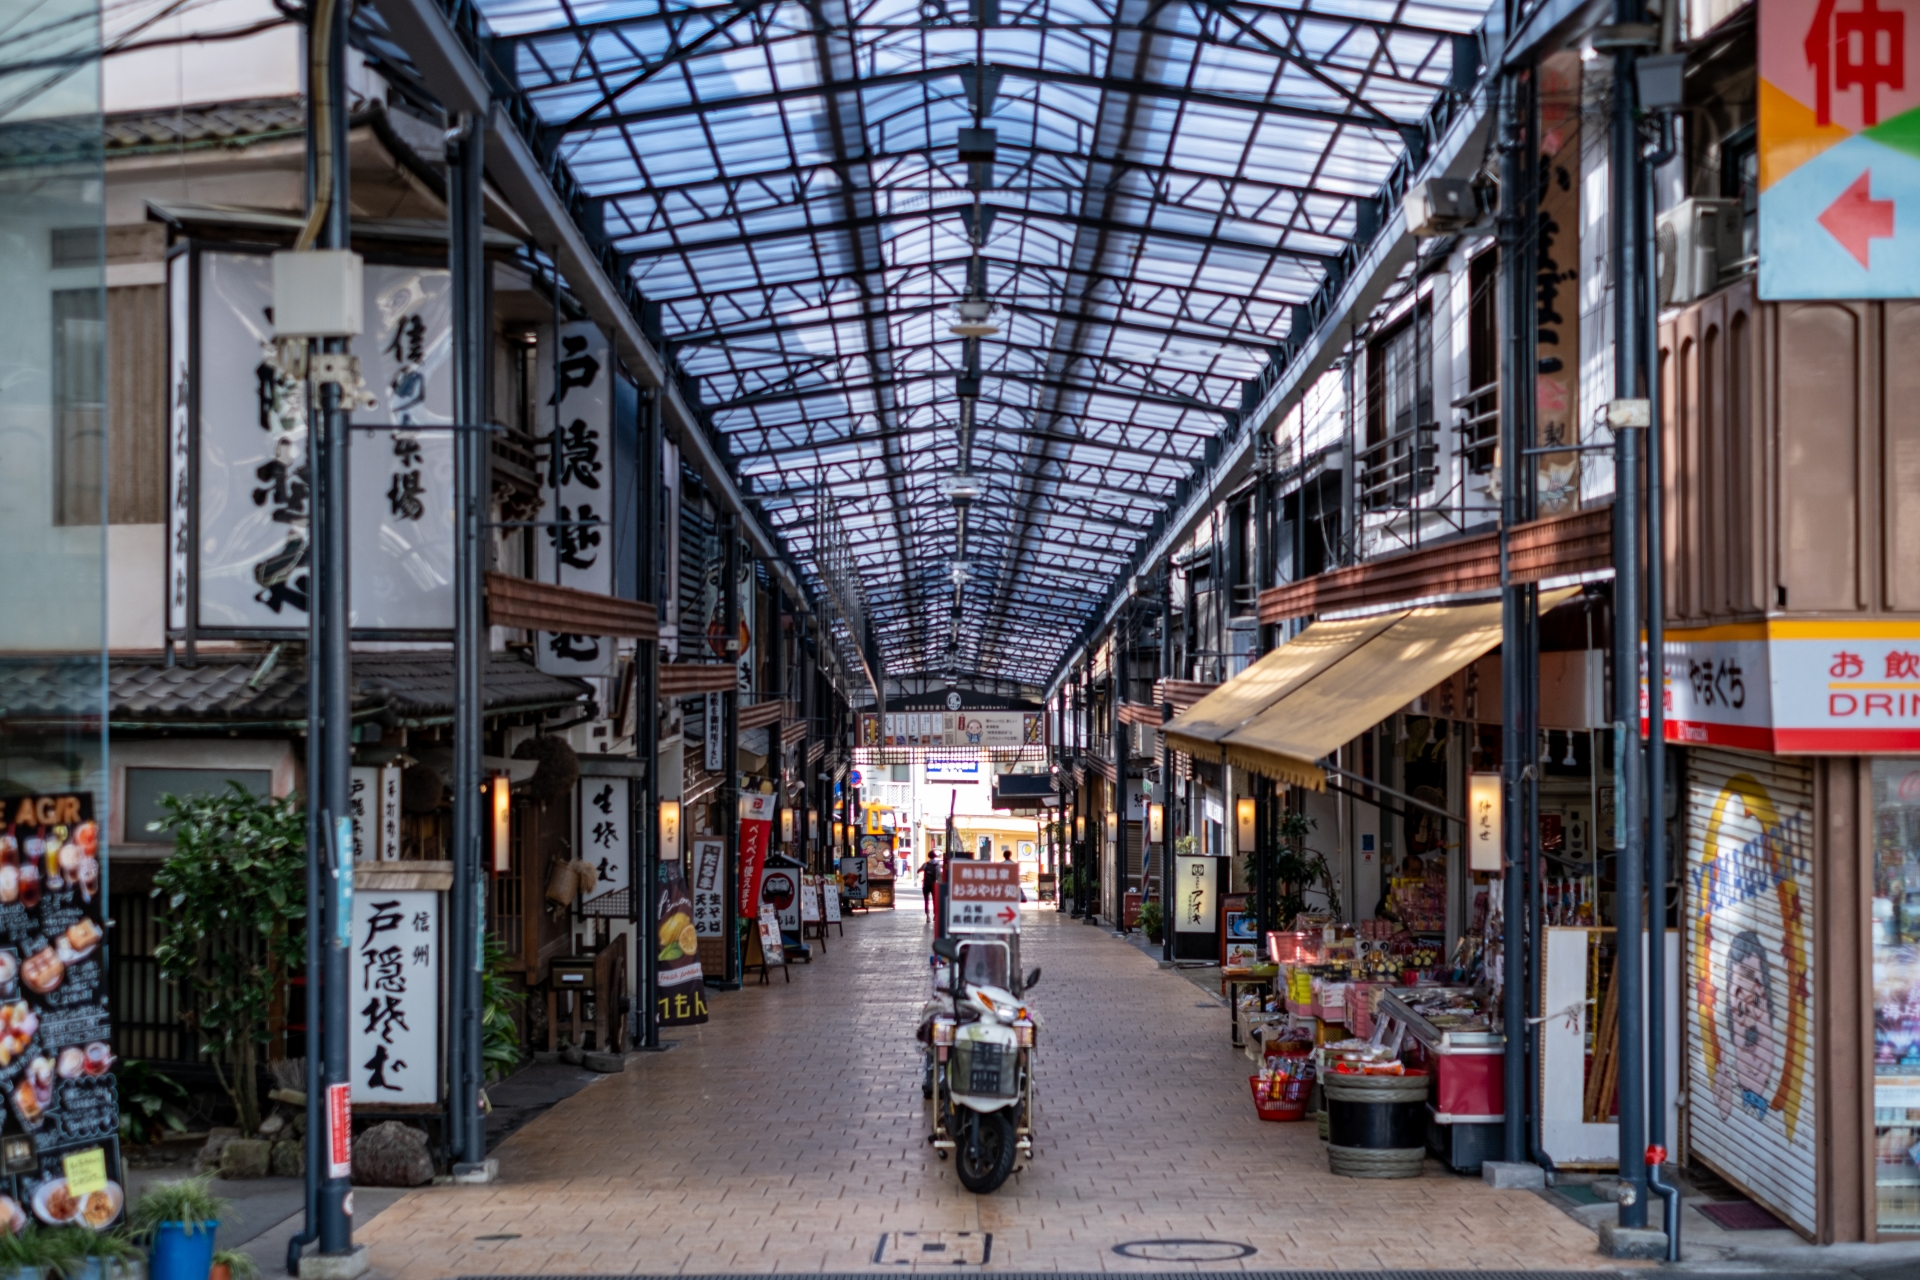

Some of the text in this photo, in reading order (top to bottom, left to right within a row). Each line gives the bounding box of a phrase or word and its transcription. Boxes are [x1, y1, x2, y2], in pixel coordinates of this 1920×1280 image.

[1688, 658, 1746, 710] やまぐち
[1478, 799, 1491, 842] 仲見世
[741, 823, 760, 914] ペイペイ使えます。
[855, 859, 867, 885] すし
[962, 867, 1010, 880] 熱海温泉
[953, 883, 1019, 898] おみやげ処
[1191, 890, 1204, 925] アオキ
[709, 893, 722, 933] 生そば
[411, 911, 430, 967] 信州
